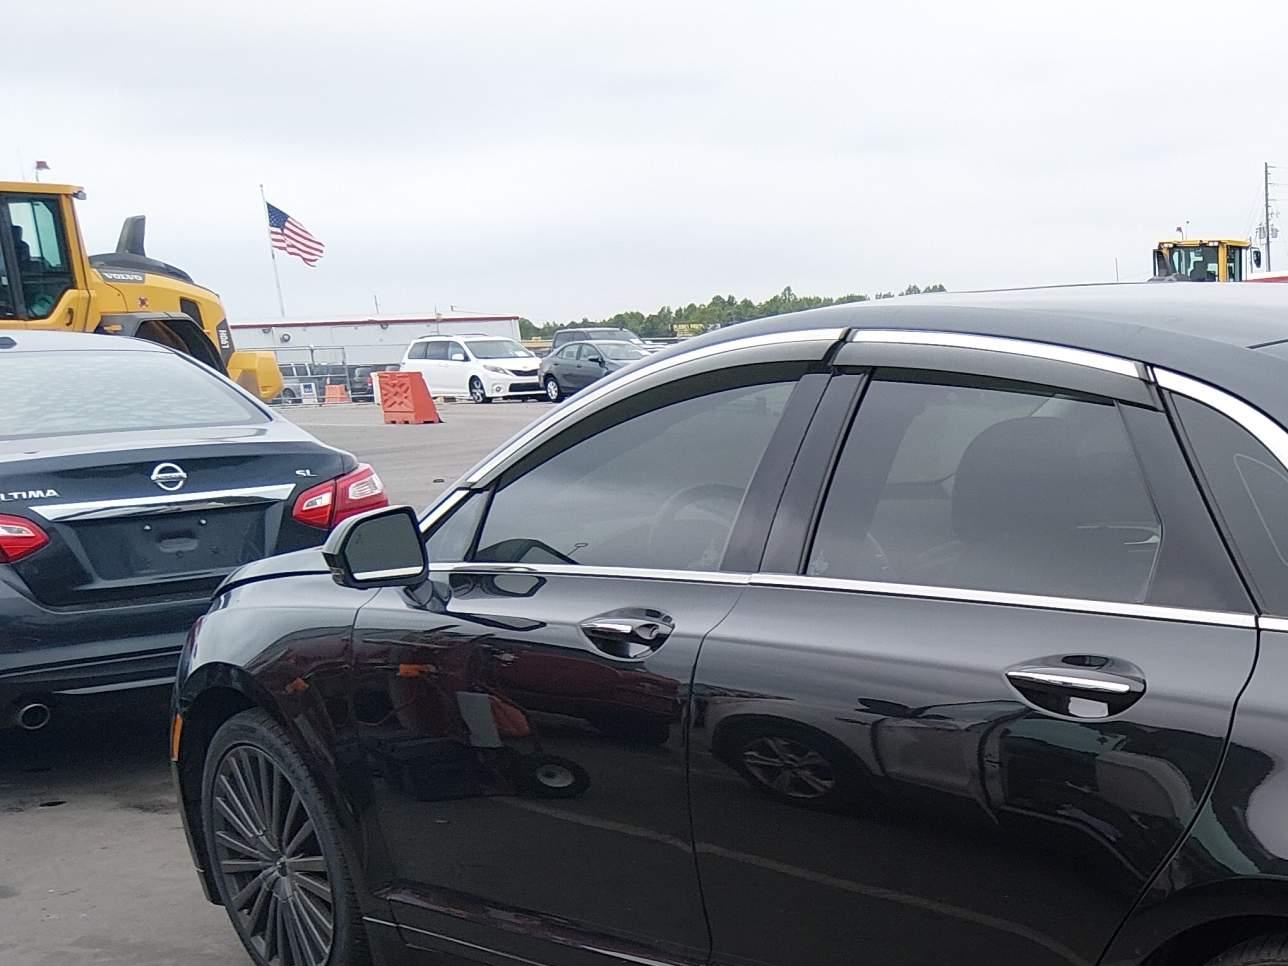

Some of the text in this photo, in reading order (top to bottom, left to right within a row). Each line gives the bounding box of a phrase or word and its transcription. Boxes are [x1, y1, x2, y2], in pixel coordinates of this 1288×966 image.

[102, 272, 143, 281] VOLVO
[295, 468, 318, 477] SL
[0, 489, 60, 501] LTIMA
